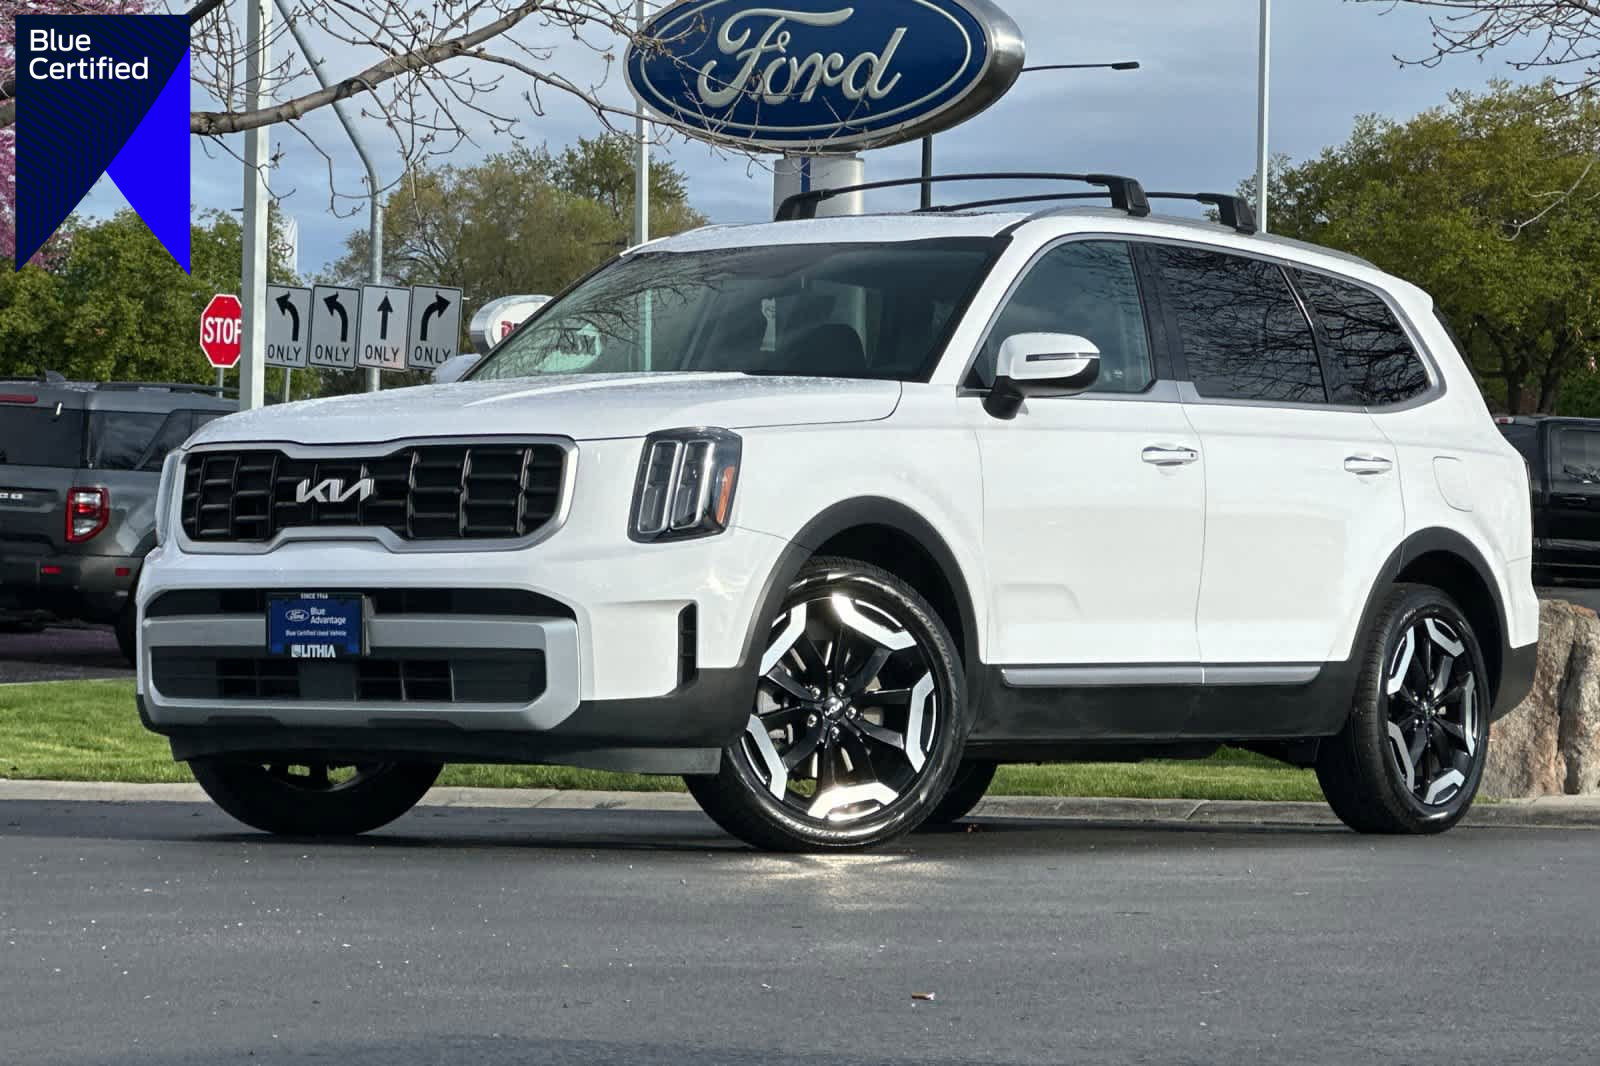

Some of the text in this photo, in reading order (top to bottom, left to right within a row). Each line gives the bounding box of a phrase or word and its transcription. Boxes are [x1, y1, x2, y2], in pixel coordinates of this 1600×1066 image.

[698, 7, 907, 107] Ford
[267, 344, 302, 362] ONLY
[315, 344, 350, 363] ONLY
[365, 344, 399, 363] ONLY
[414, 345, 451, 364] ONLY
[295, 478, 374, 503] KIA
[310, 607, 325, 615] Blue
[310, 616, 346, 625] Advantage
[302, 644, 336, 658] LITHIA
